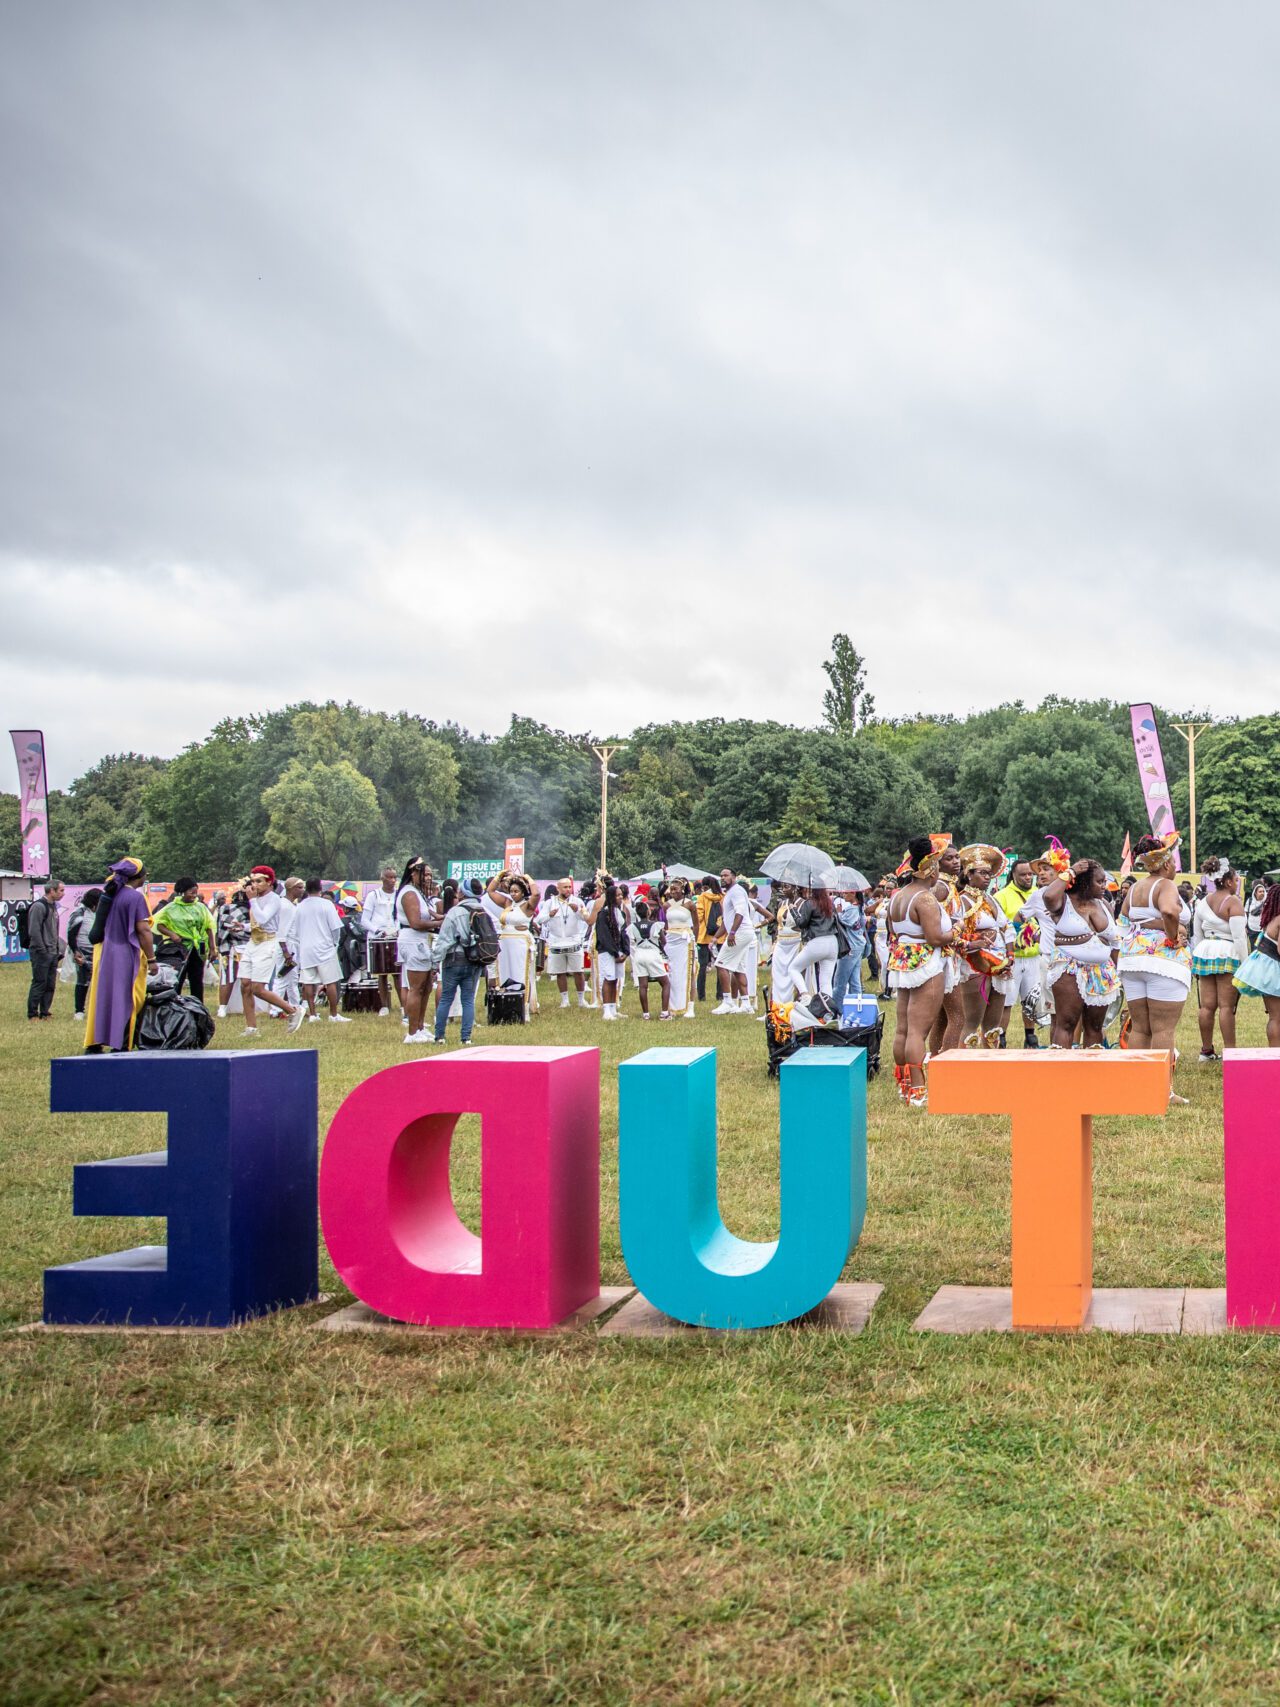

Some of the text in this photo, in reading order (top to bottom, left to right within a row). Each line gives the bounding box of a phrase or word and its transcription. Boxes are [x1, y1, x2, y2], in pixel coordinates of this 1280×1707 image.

[464, 862, 502, 871] ISSUE DE
[463, 871, 499, 879] SECOUR
